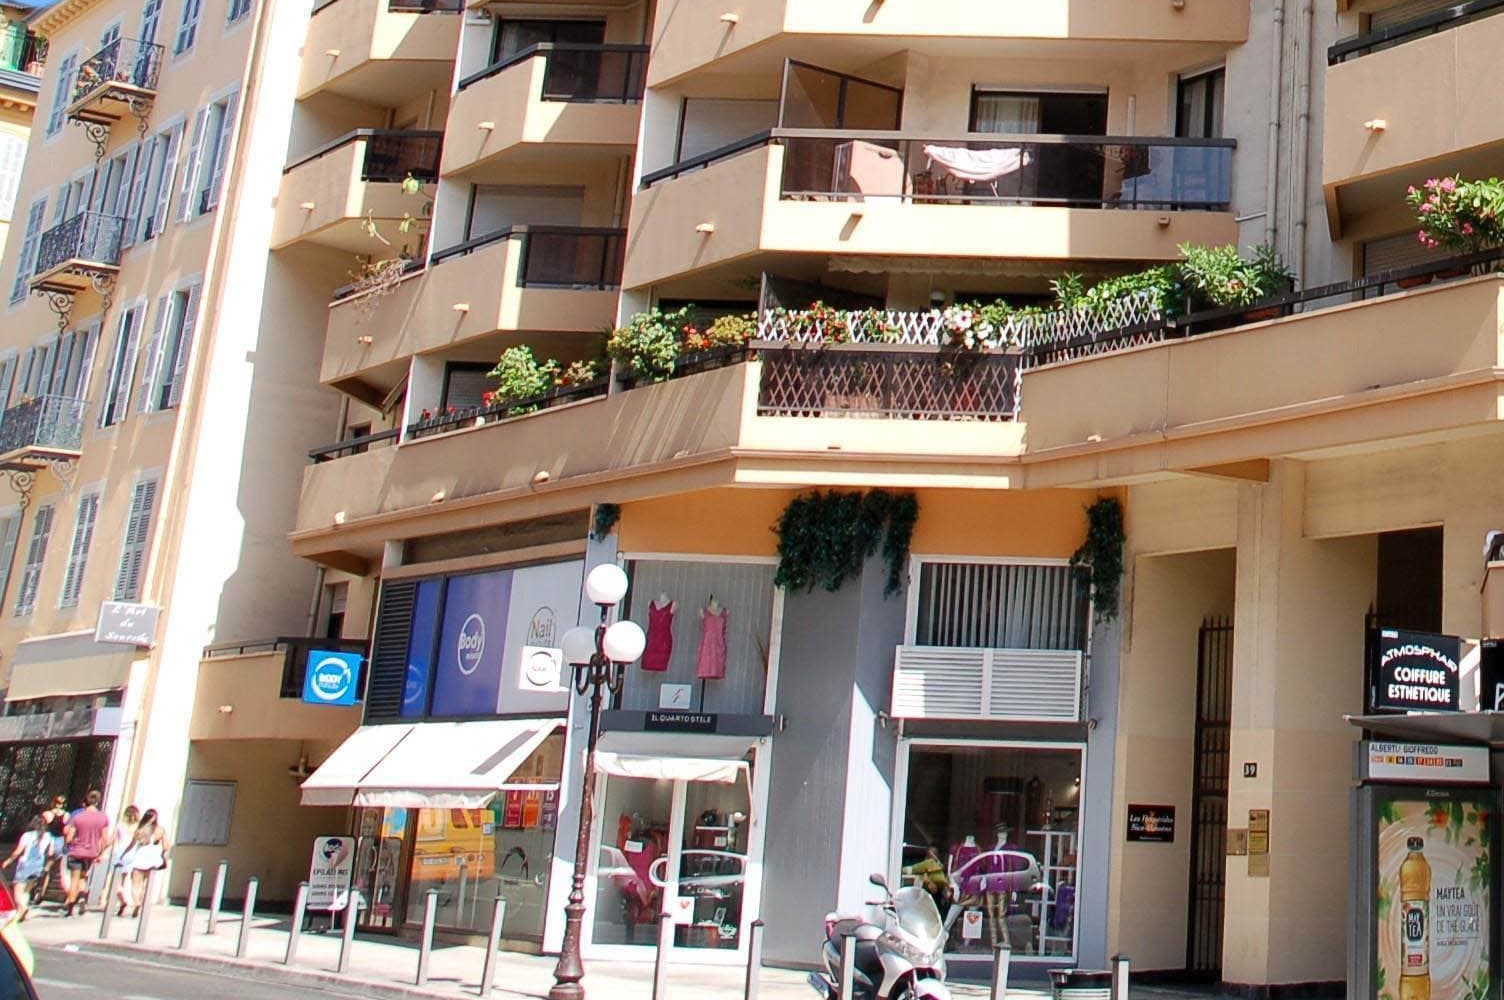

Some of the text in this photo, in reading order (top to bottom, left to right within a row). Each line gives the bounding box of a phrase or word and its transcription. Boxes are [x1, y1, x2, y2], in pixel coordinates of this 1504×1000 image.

[530, 616, 552, 639] Nail
[459, 632, 483, 651] Body
[1394, 666, 1446, 685] COIFFURE
[1388, 684, 1451, 703] ESTHETIQUE
[1436, 887, 1465, 900] MAYTEA
